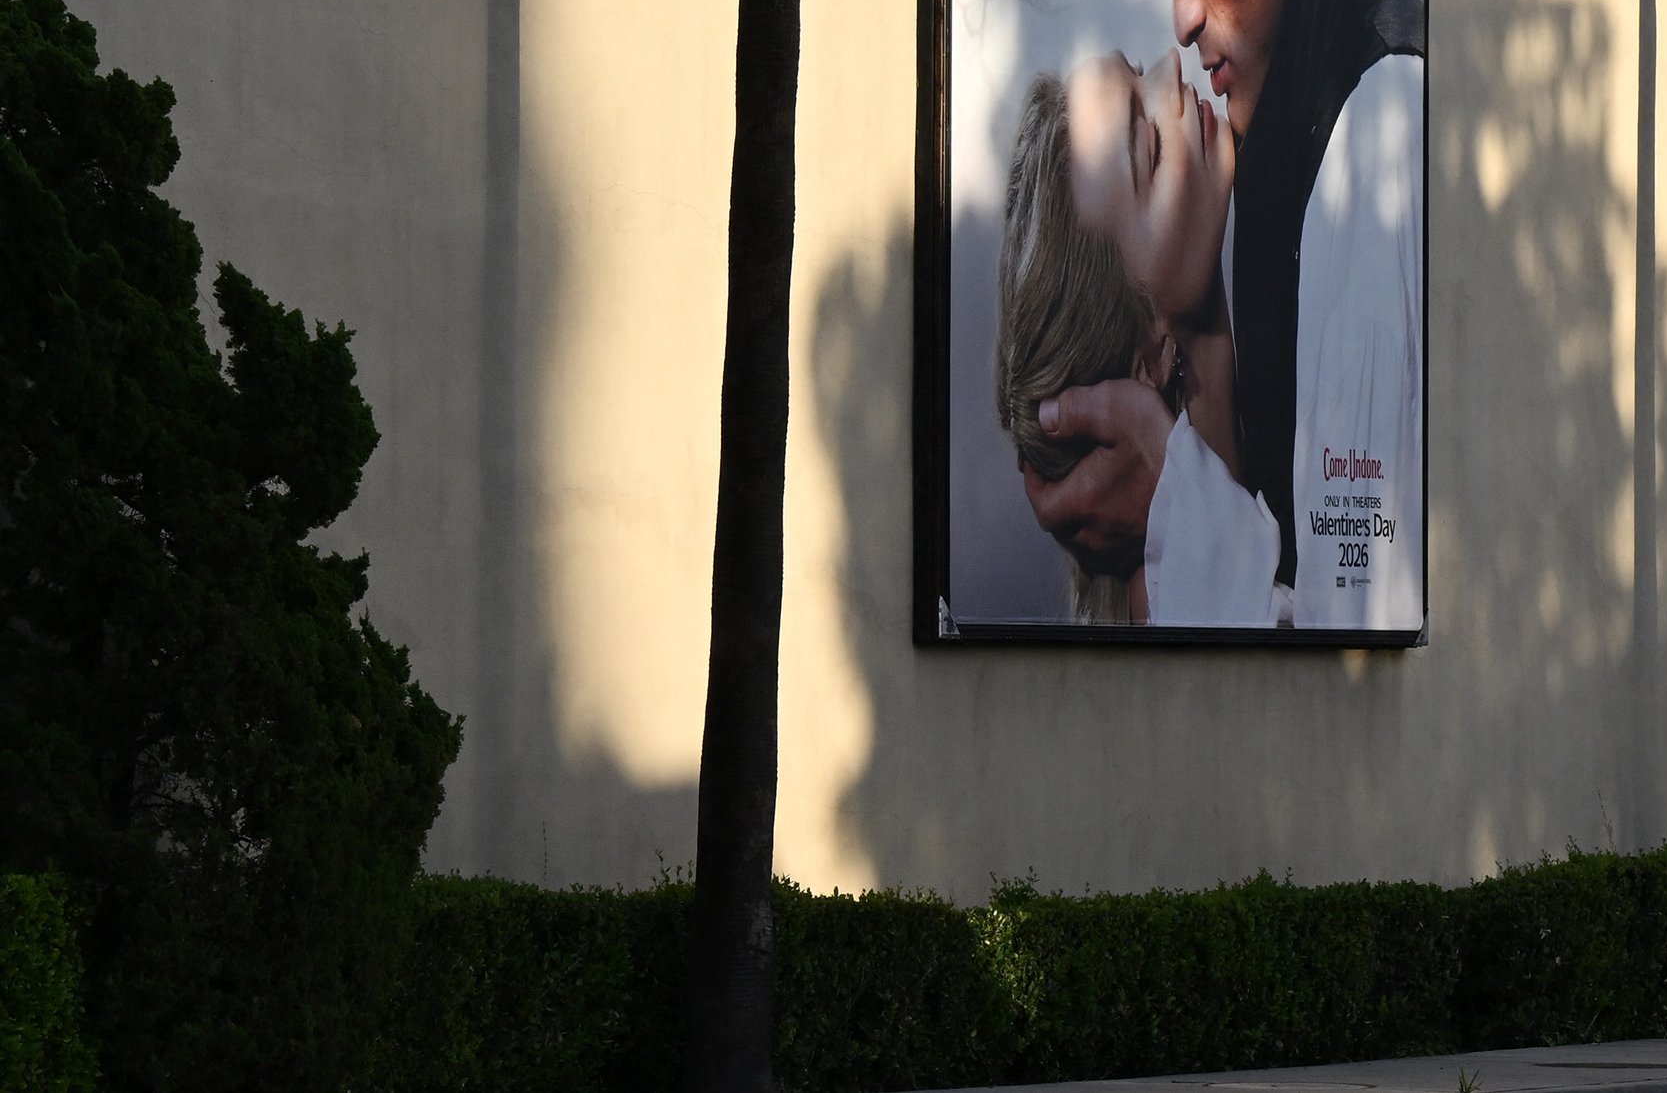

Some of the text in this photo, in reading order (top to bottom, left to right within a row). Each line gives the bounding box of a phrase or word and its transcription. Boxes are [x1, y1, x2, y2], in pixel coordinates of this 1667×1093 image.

[1323, 447, 1384, 482] Come Undone.
[1324, 495, 1382, 509] ONLY IN THEATERS
[1309, 511, 1397, 543] Valentine's Day
[1338, 542, 1369, 568] 2026
